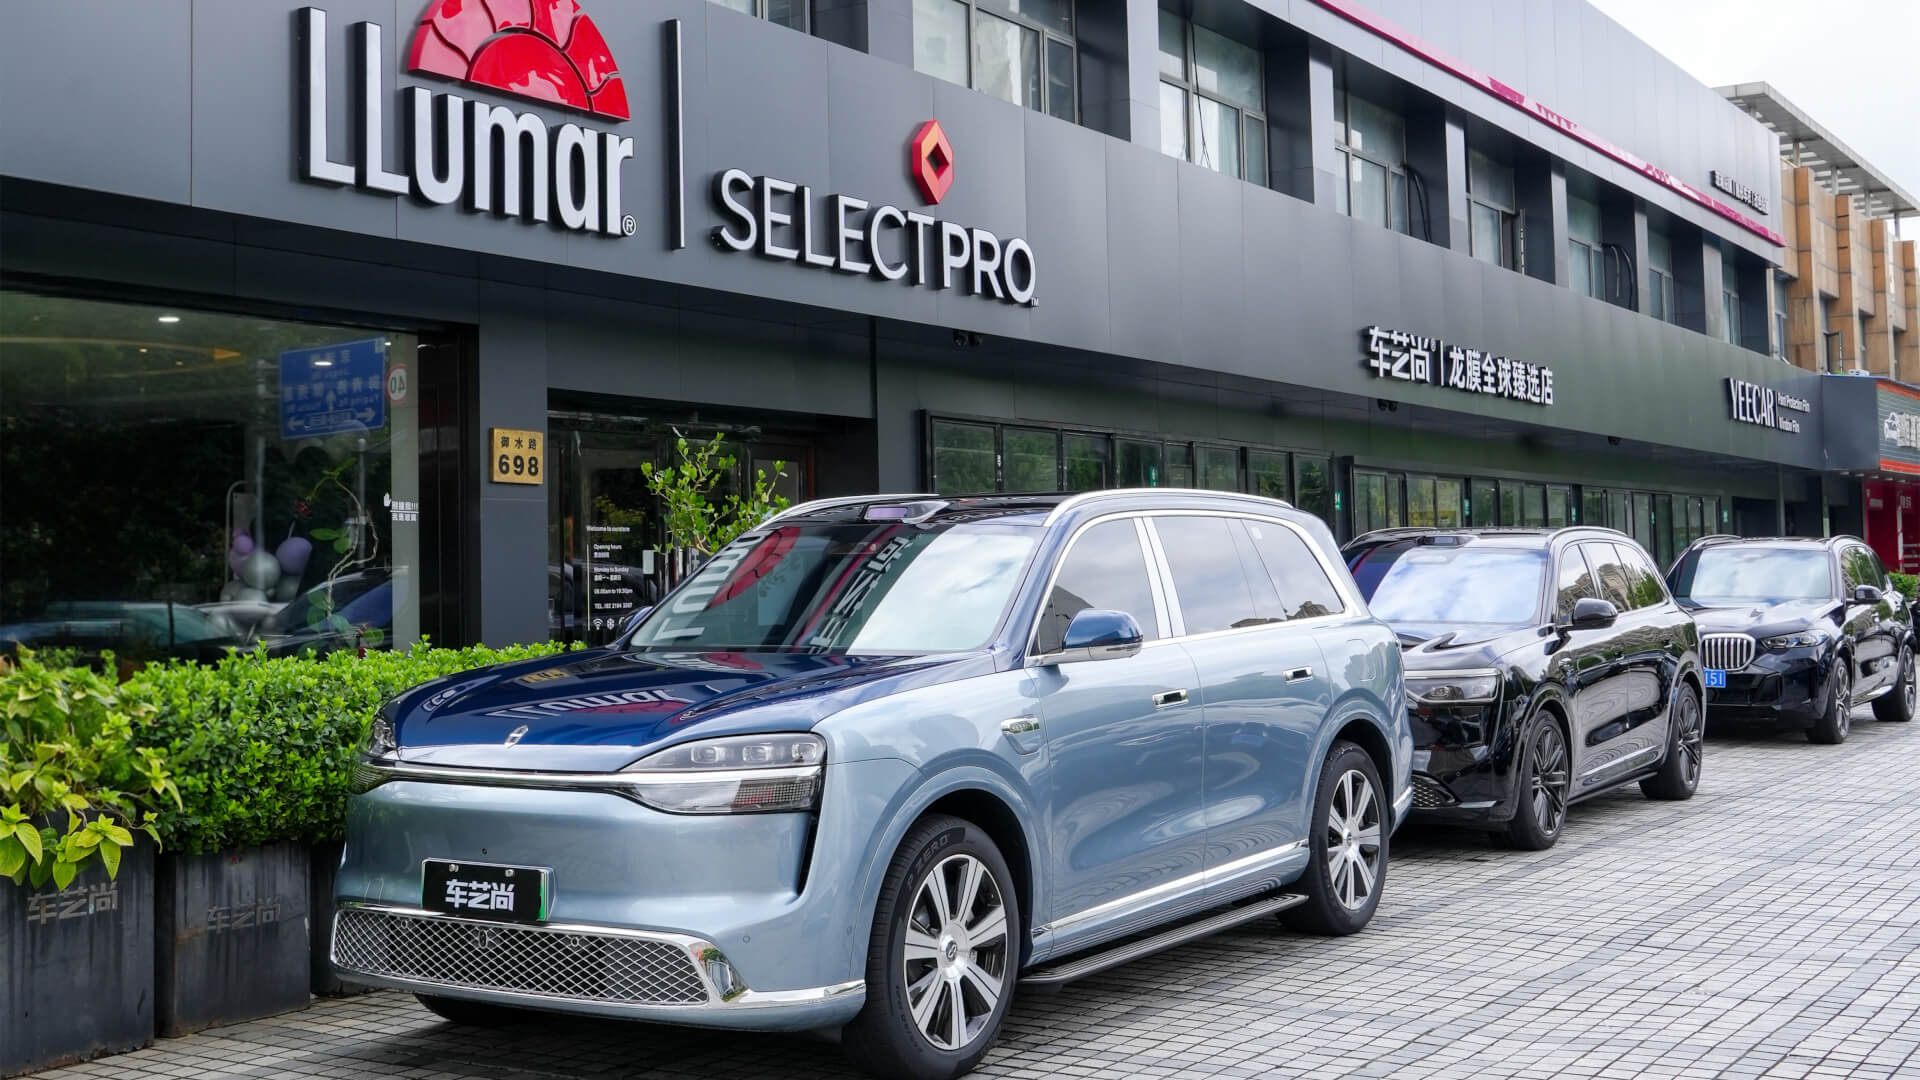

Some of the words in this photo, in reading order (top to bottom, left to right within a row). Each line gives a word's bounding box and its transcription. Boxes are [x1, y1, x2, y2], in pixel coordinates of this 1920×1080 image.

[1449, 345, 1553, 405] 龙膜全球臻选店
[1730, 377, 1775, 427] YEECAR
[499, 454, 539, 476] 698
[26, 880, 119, 925] 车艺尚
[445, 878, 515, 912] 车艺尚
